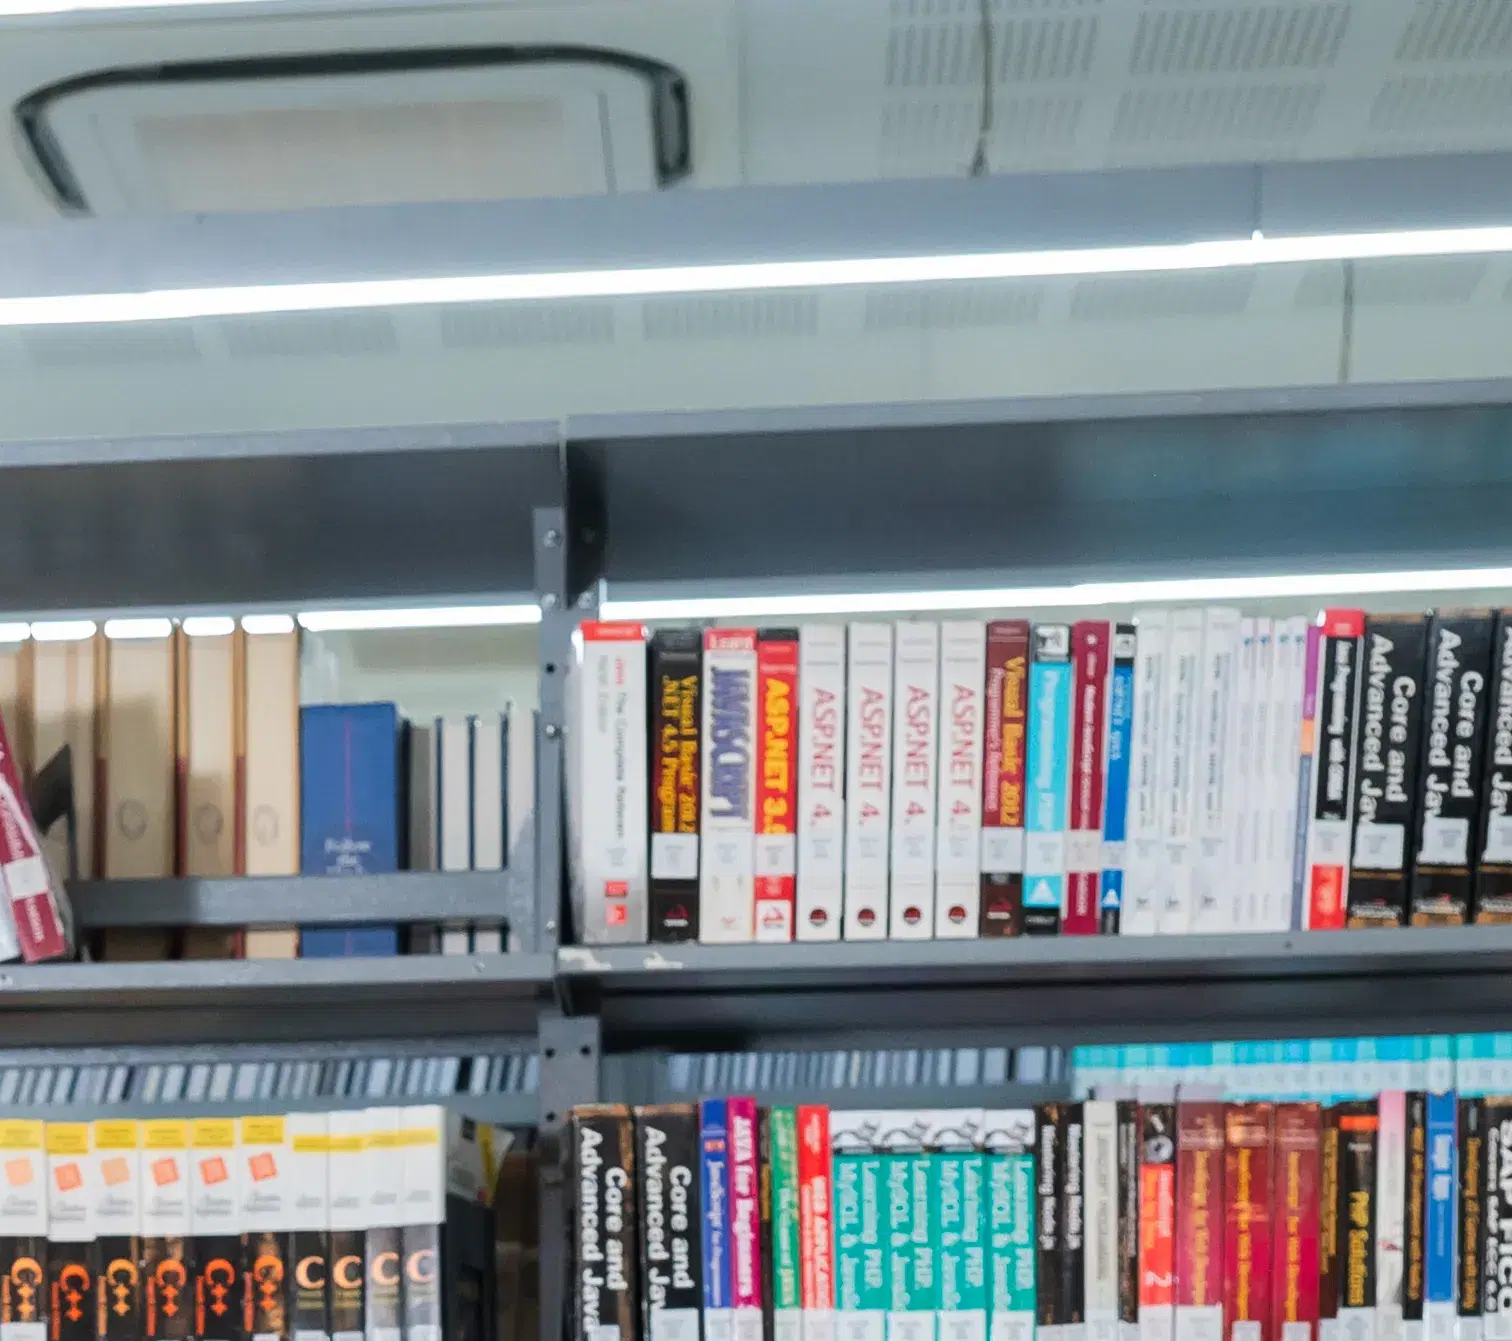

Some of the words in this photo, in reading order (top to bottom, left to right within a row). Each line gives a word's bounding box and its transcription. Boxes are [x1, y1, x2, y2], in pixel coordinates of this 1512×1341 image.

[1002, 656, 1022, 719] Visual
[1362, 634, 1389, 772] Advanced
[1389, 675, 1415, 741] Core
[711, 666, 749, 819] JAVASCRIPT
[763, 680, 787, 792] ASP.NET
[813, 688, 836, 792] ASP.NET
[859, 687, 883, 792] ASP.NET
[906, 686, 930, 790] ASP.NET
[950, 684, 971, 789] ASP.NET
[1002, 725, 1022, 773] Basic
[1002, 781, 1024, 825] 2012
[1386, 749, 1408, 802] and
[735, 1116, 753, 1162] JAVA
[580, 1128, 603, 1262] Advanced
[604, 1168, 626, 1232] Core
[644, 1127, 668, 1261] Advanced
[672, 1167, 691, 1232] Core
[737, 1167, 753, 1194] for
[839, 1161, 858, 1227] MySQL
[861, 1160, 880, 1240] Learning
[891, 1161, 910, 1227] MySQL
[913, 1160, 932, 1240] Learning
[606, 1240, 628, 1289] and
[674, 1239, 694, 1288] and
[737, 1200, 756, 1296] Beginners
[10, 1257, 44, 1318] C++
[58, 1264, 89, 1321] C++
[106, 1258, 138, 1316] C++
